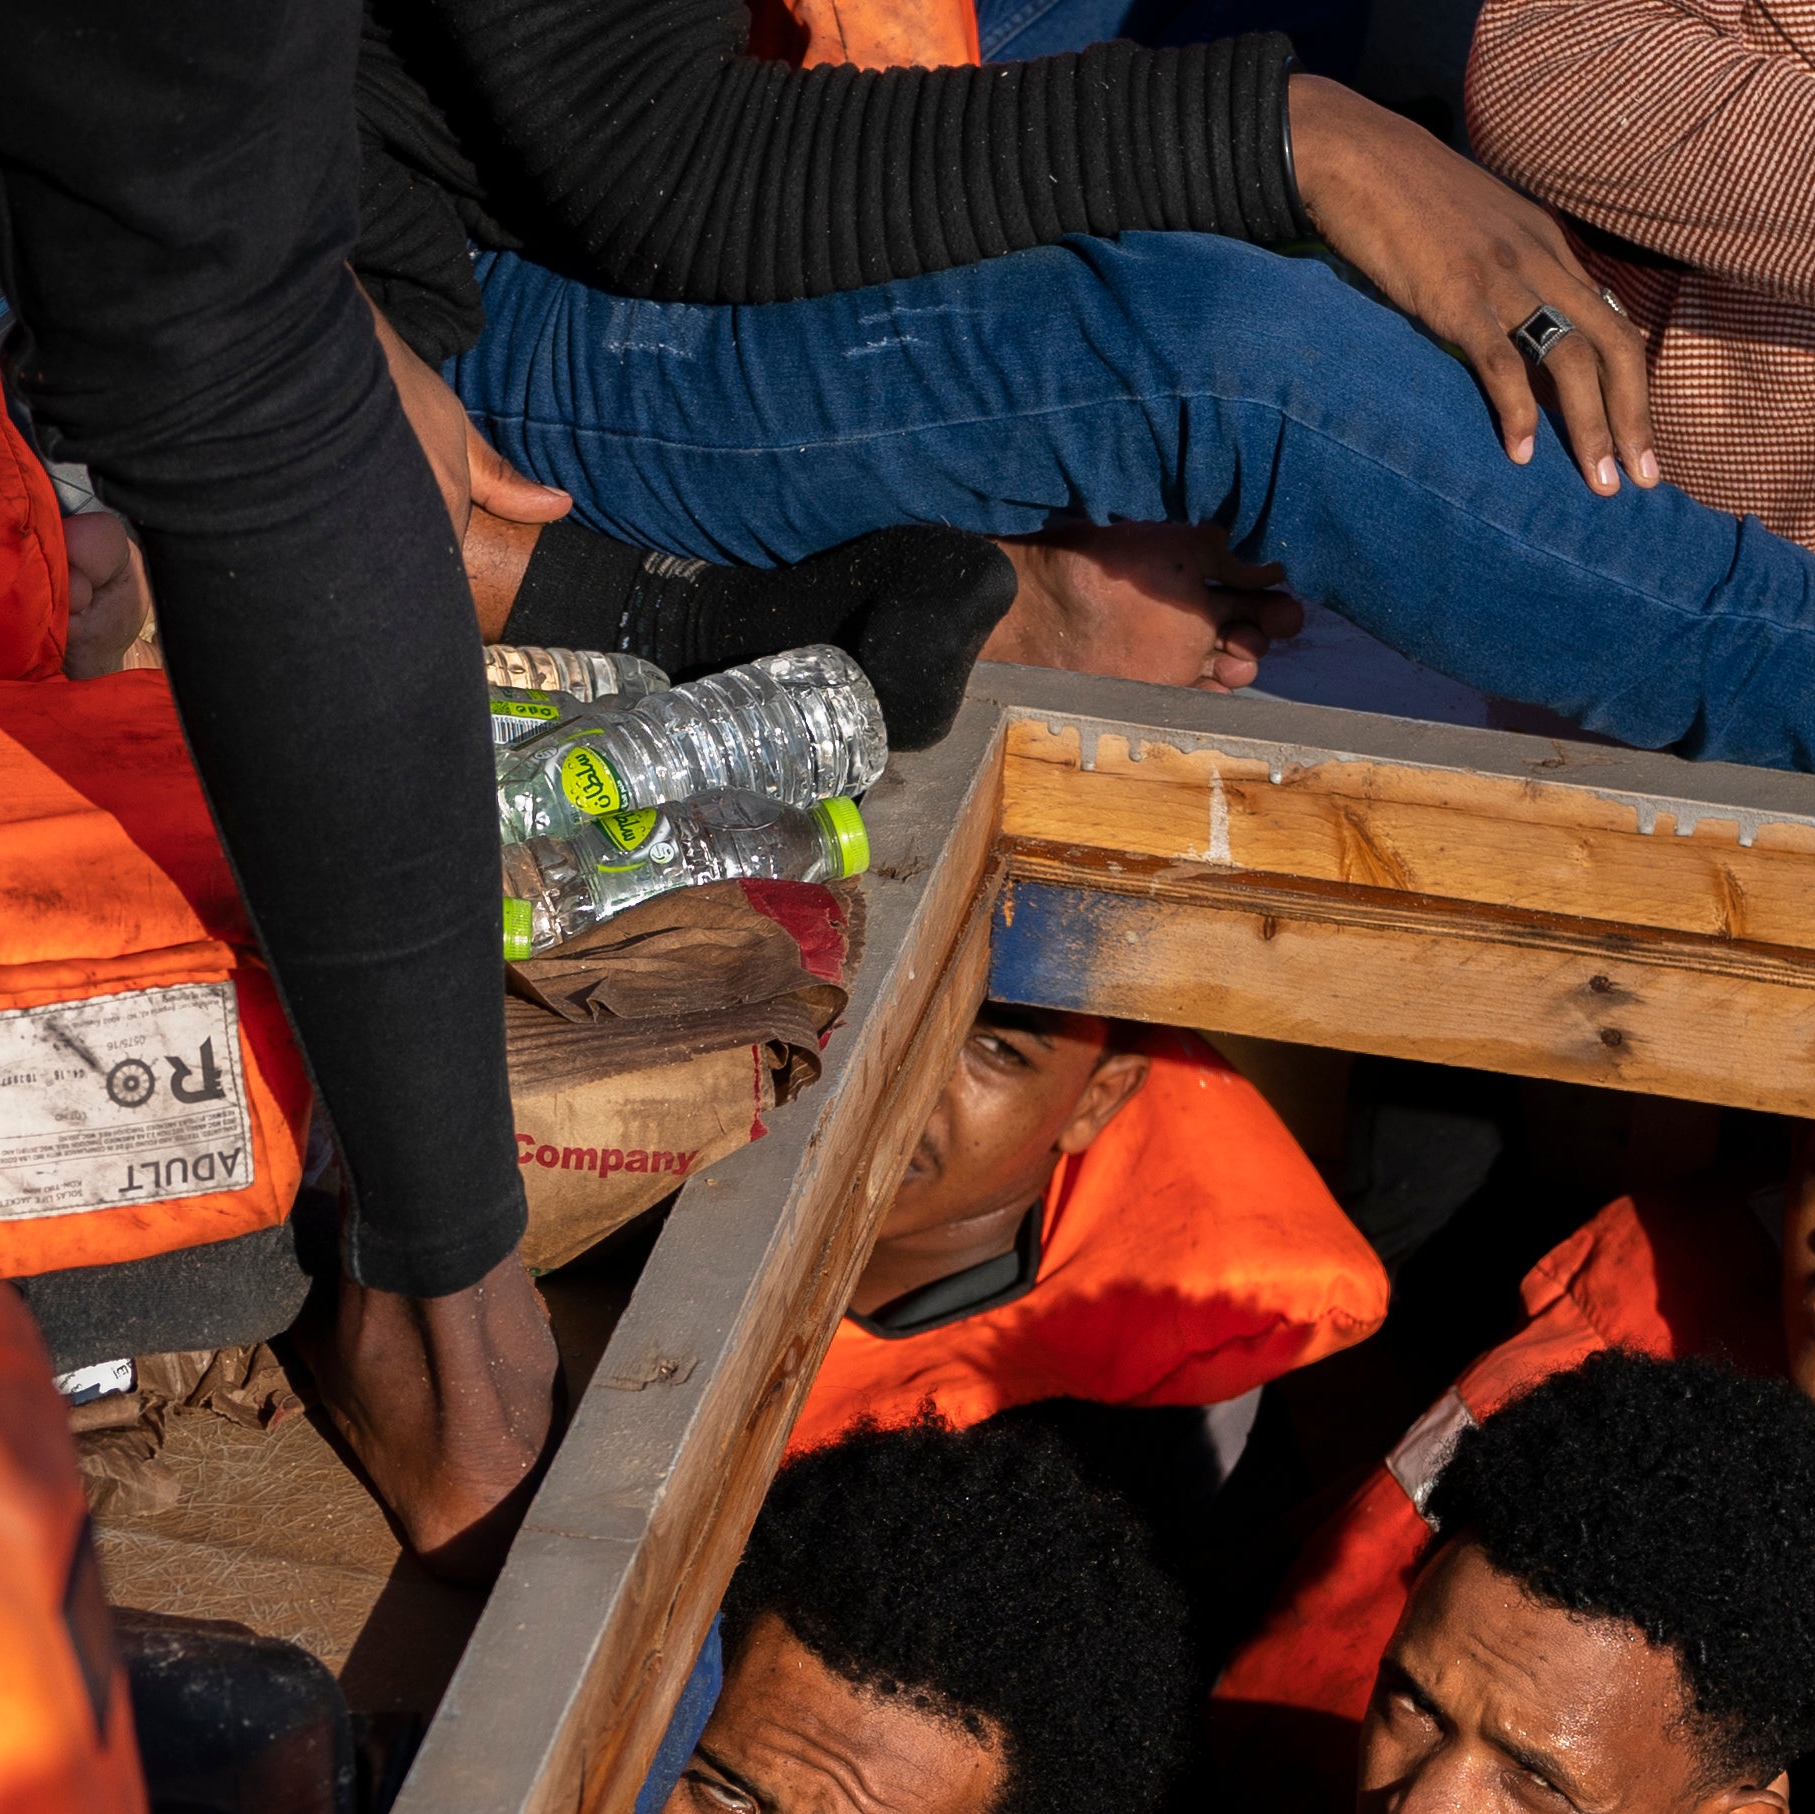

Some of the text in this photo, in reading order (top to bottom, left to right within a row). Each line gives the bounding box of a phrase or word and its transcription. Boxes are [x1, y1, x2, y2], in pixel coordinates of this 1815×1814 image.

[574, 753, 611, 810] سلطان
[106, 1035, 145, 1051] 0575/16
[119, 1147, 240, 1192] ADULT
[515, 1133, 700, 1179] Company
[35, 1194, 52, 1203] LIFE
[56, 1189, 82, 1199] SOLAS
